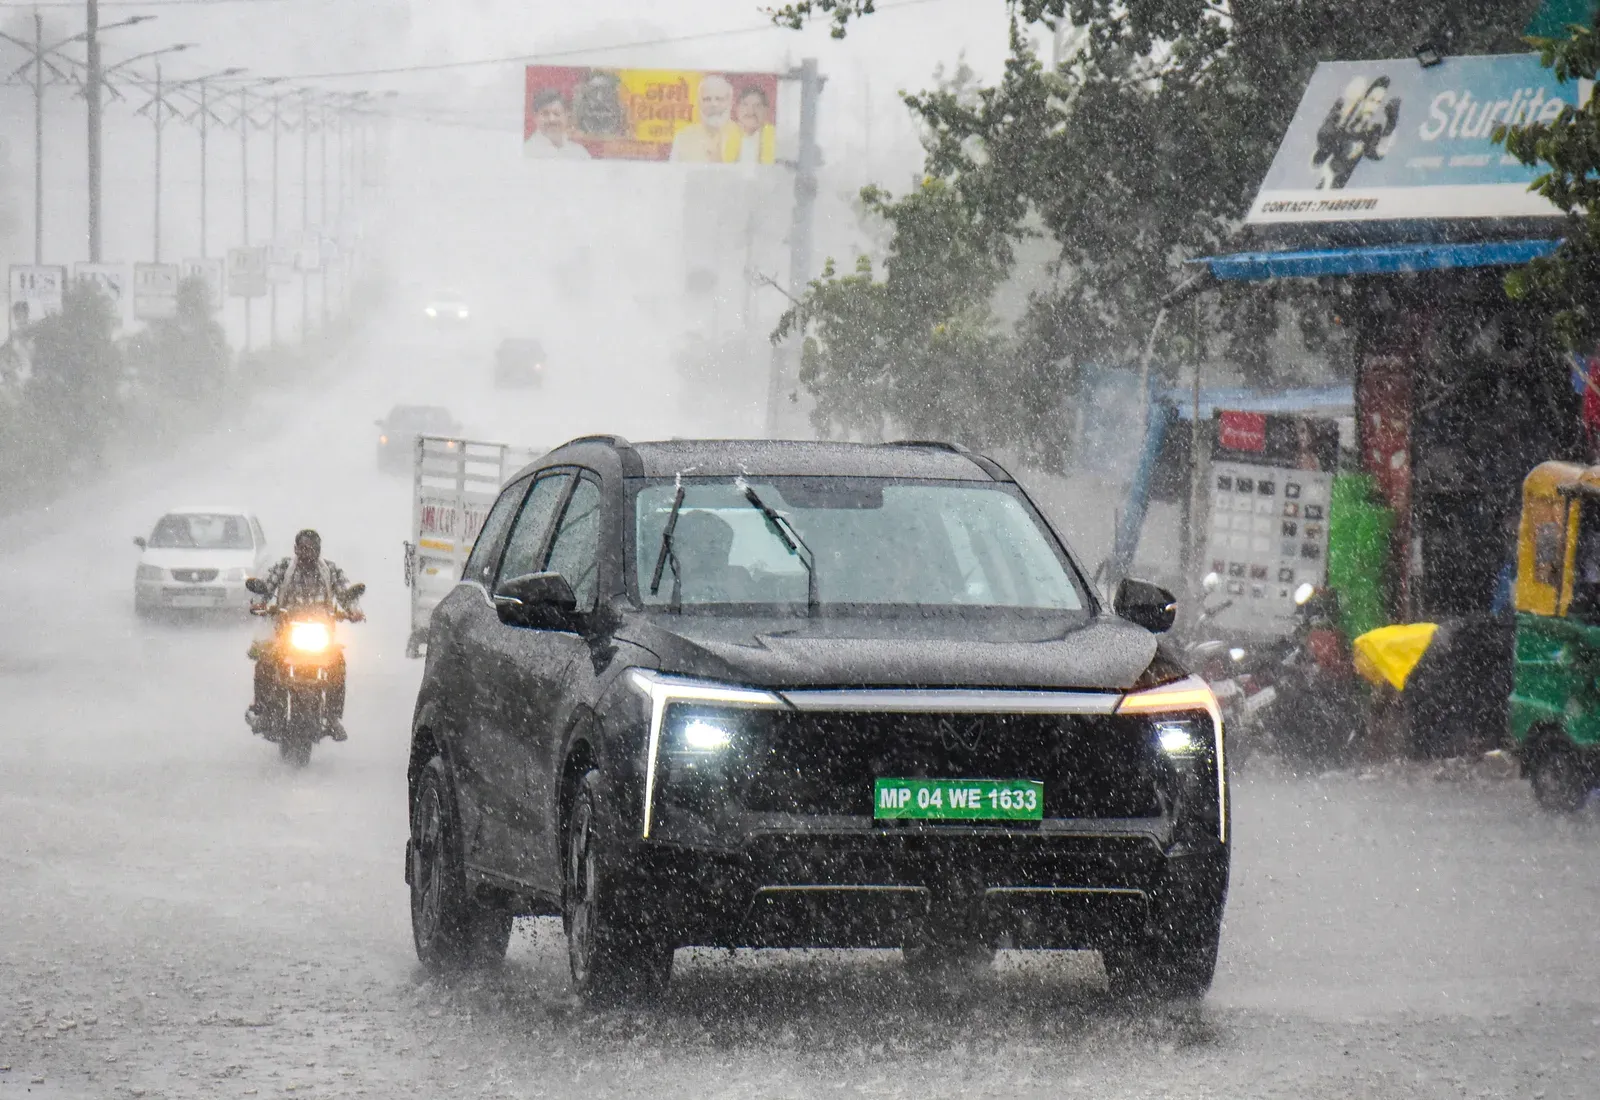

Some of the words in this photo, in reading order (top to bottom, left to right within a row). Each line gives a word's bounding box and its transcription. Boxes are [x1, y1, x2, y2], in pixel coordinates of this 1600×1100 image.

[1419, 87, 1564, 141] Sturlite
[880, 788, 911, 808] MP
[917, 788, 942, 808] 04
[949, 788, 981, 809] WE
[988, 789, 1037, 810] 1633
